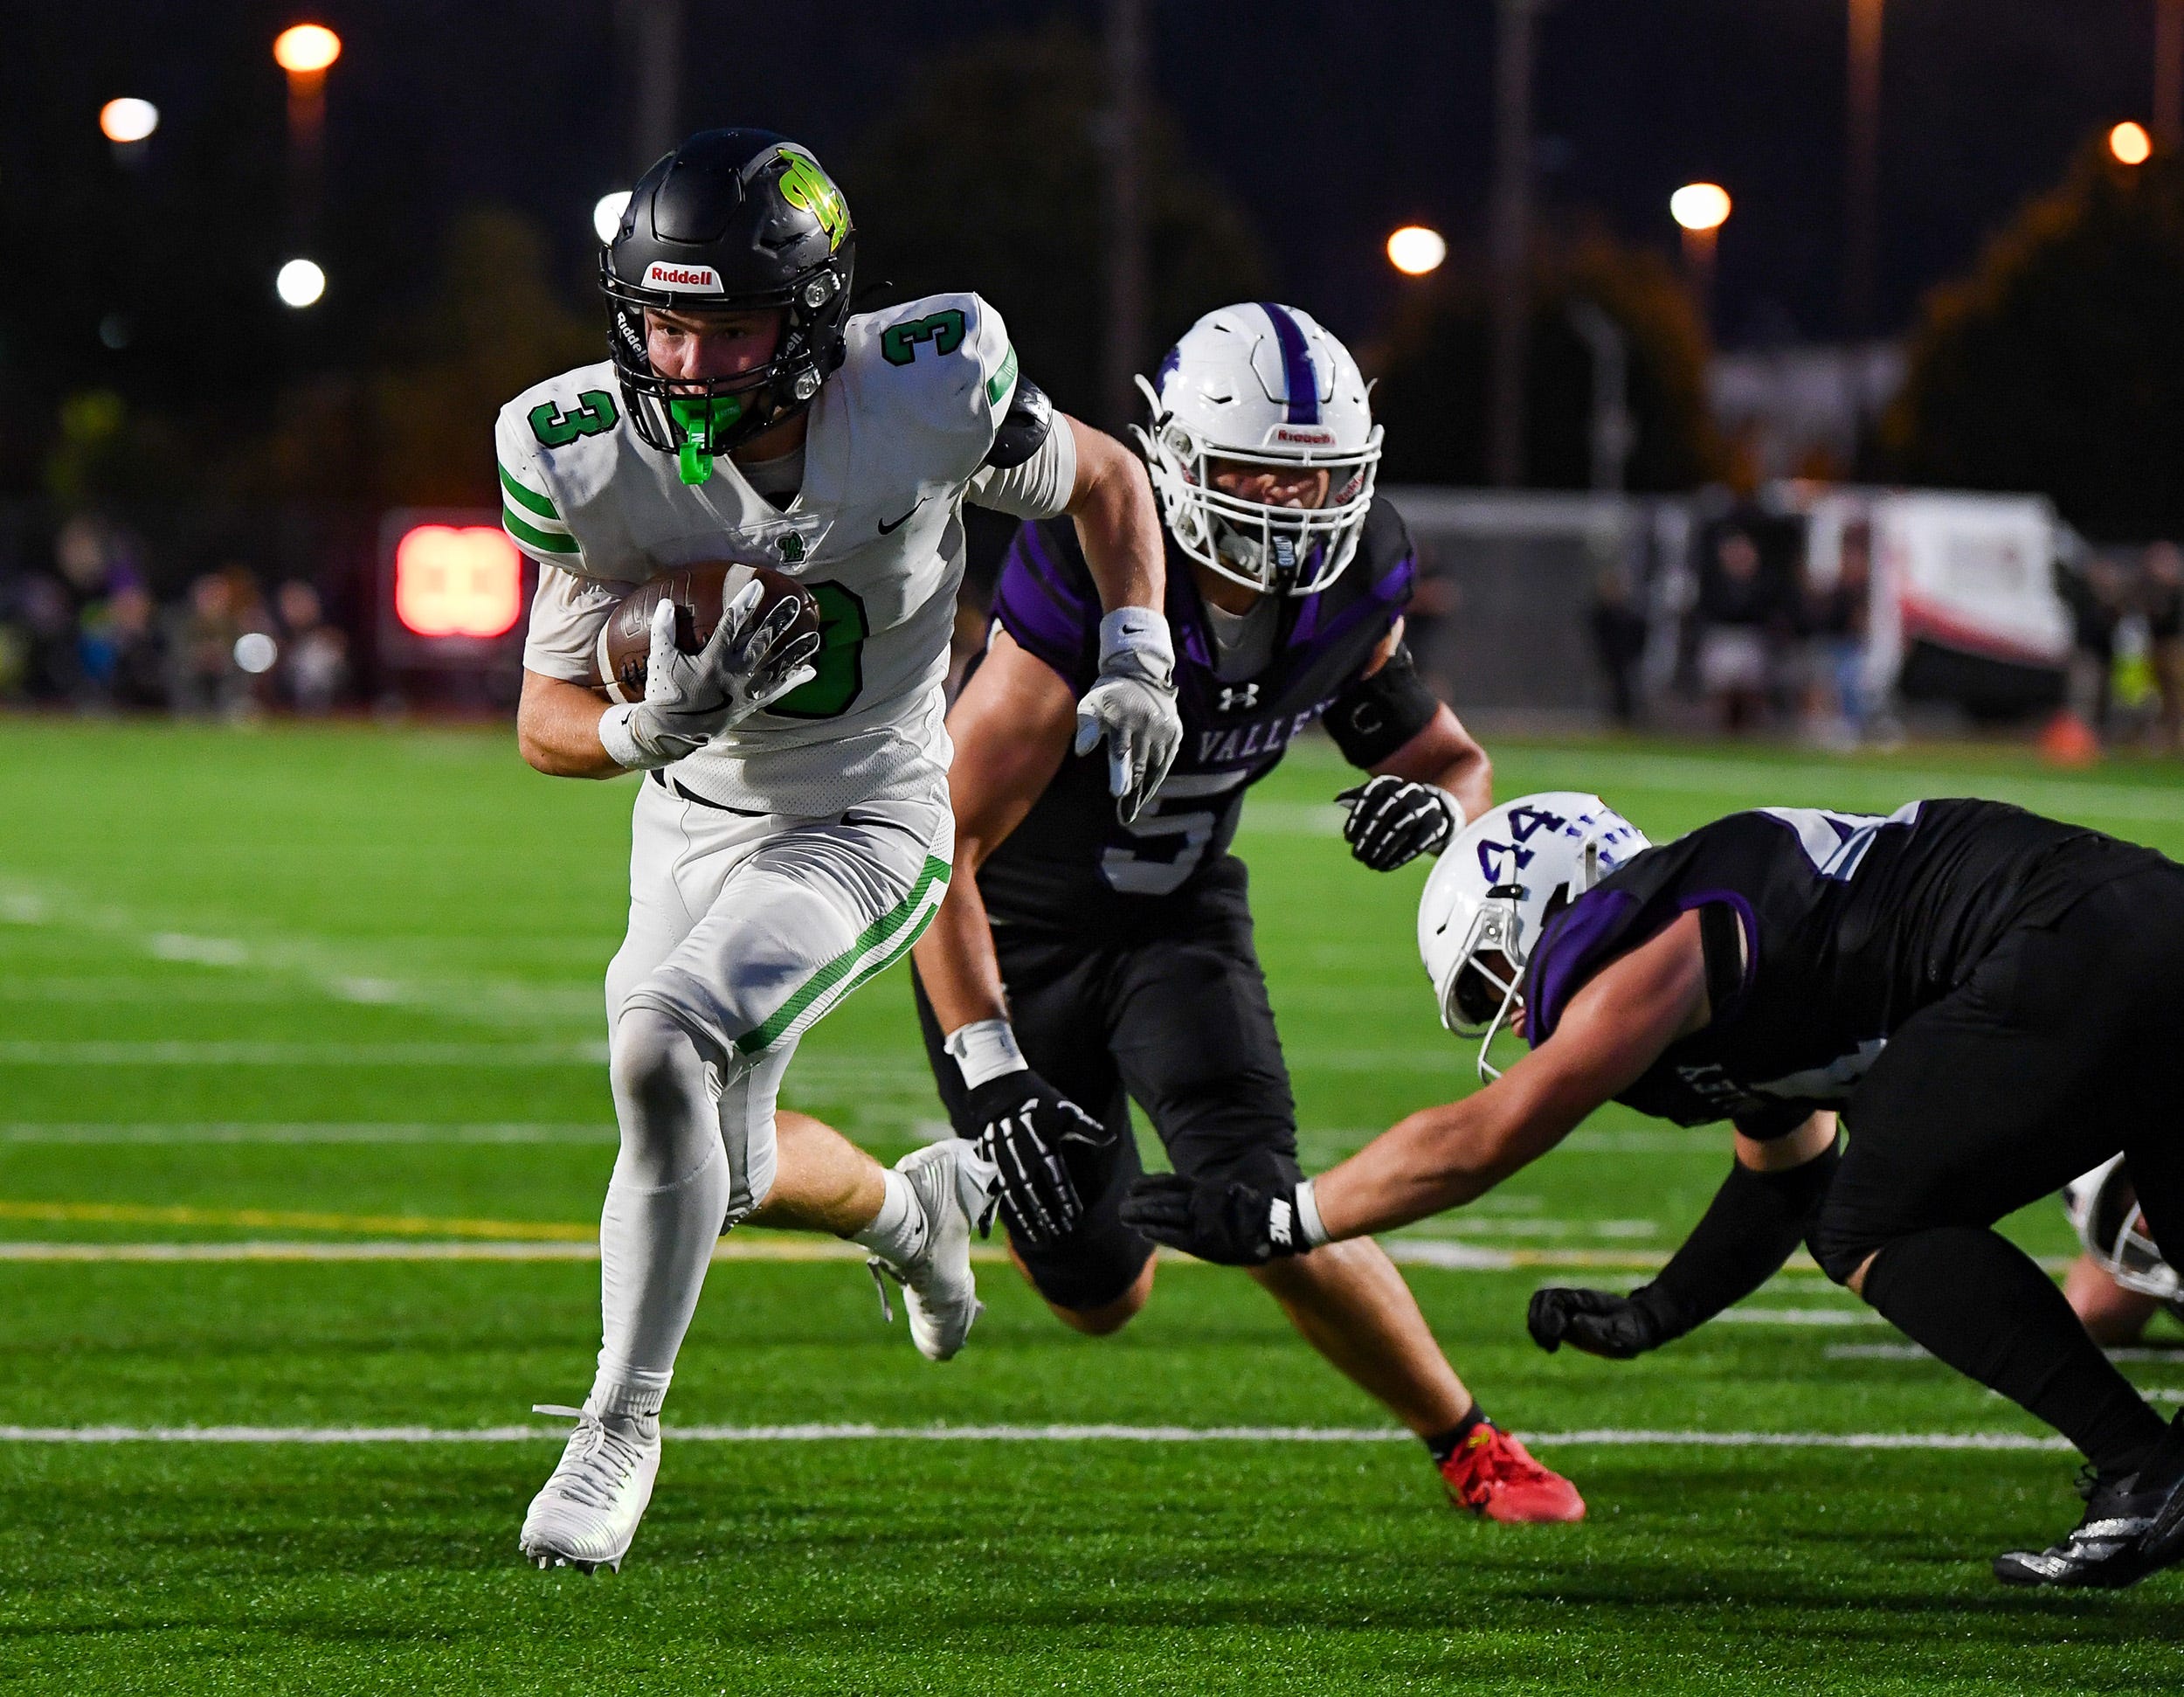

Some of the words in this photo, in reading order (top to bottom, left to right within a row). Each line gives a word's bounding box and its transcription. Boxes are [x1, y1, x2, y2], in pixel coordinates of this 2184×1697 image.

[652, 267, 712, 285] Riddell
[617, 311, 649, 363] Riddell
[881, 308, 966, 367] 3
[526, 389, 620, 450] 3
[1101, 769, 1248, 896] 5
[1476, 804, 1566, 883] 44
